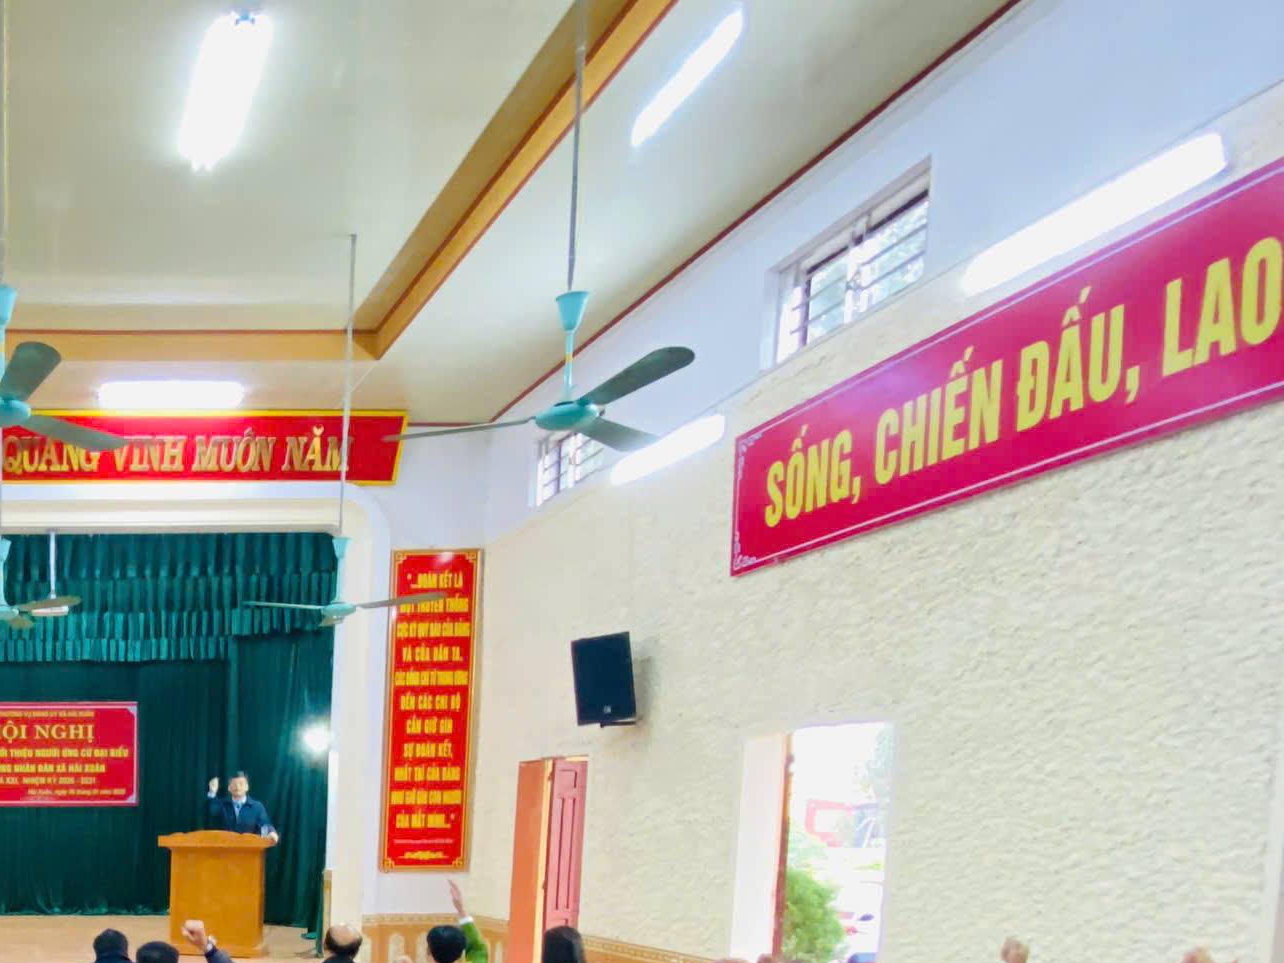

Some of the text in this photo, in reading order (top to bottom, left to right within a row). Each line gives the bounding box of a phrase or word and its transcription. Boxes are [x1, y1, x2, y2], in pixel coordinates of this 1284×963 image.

[764, 236, 1283, 528] SỐNG, CHIẾN ĐẤU, LAO
[2, 435, 100, 475] QUANG
[114, 435, 187, 472] VINH
[281, 424, 354, 472] NĂM
[33, 723, 95, 743] NGHỊ
